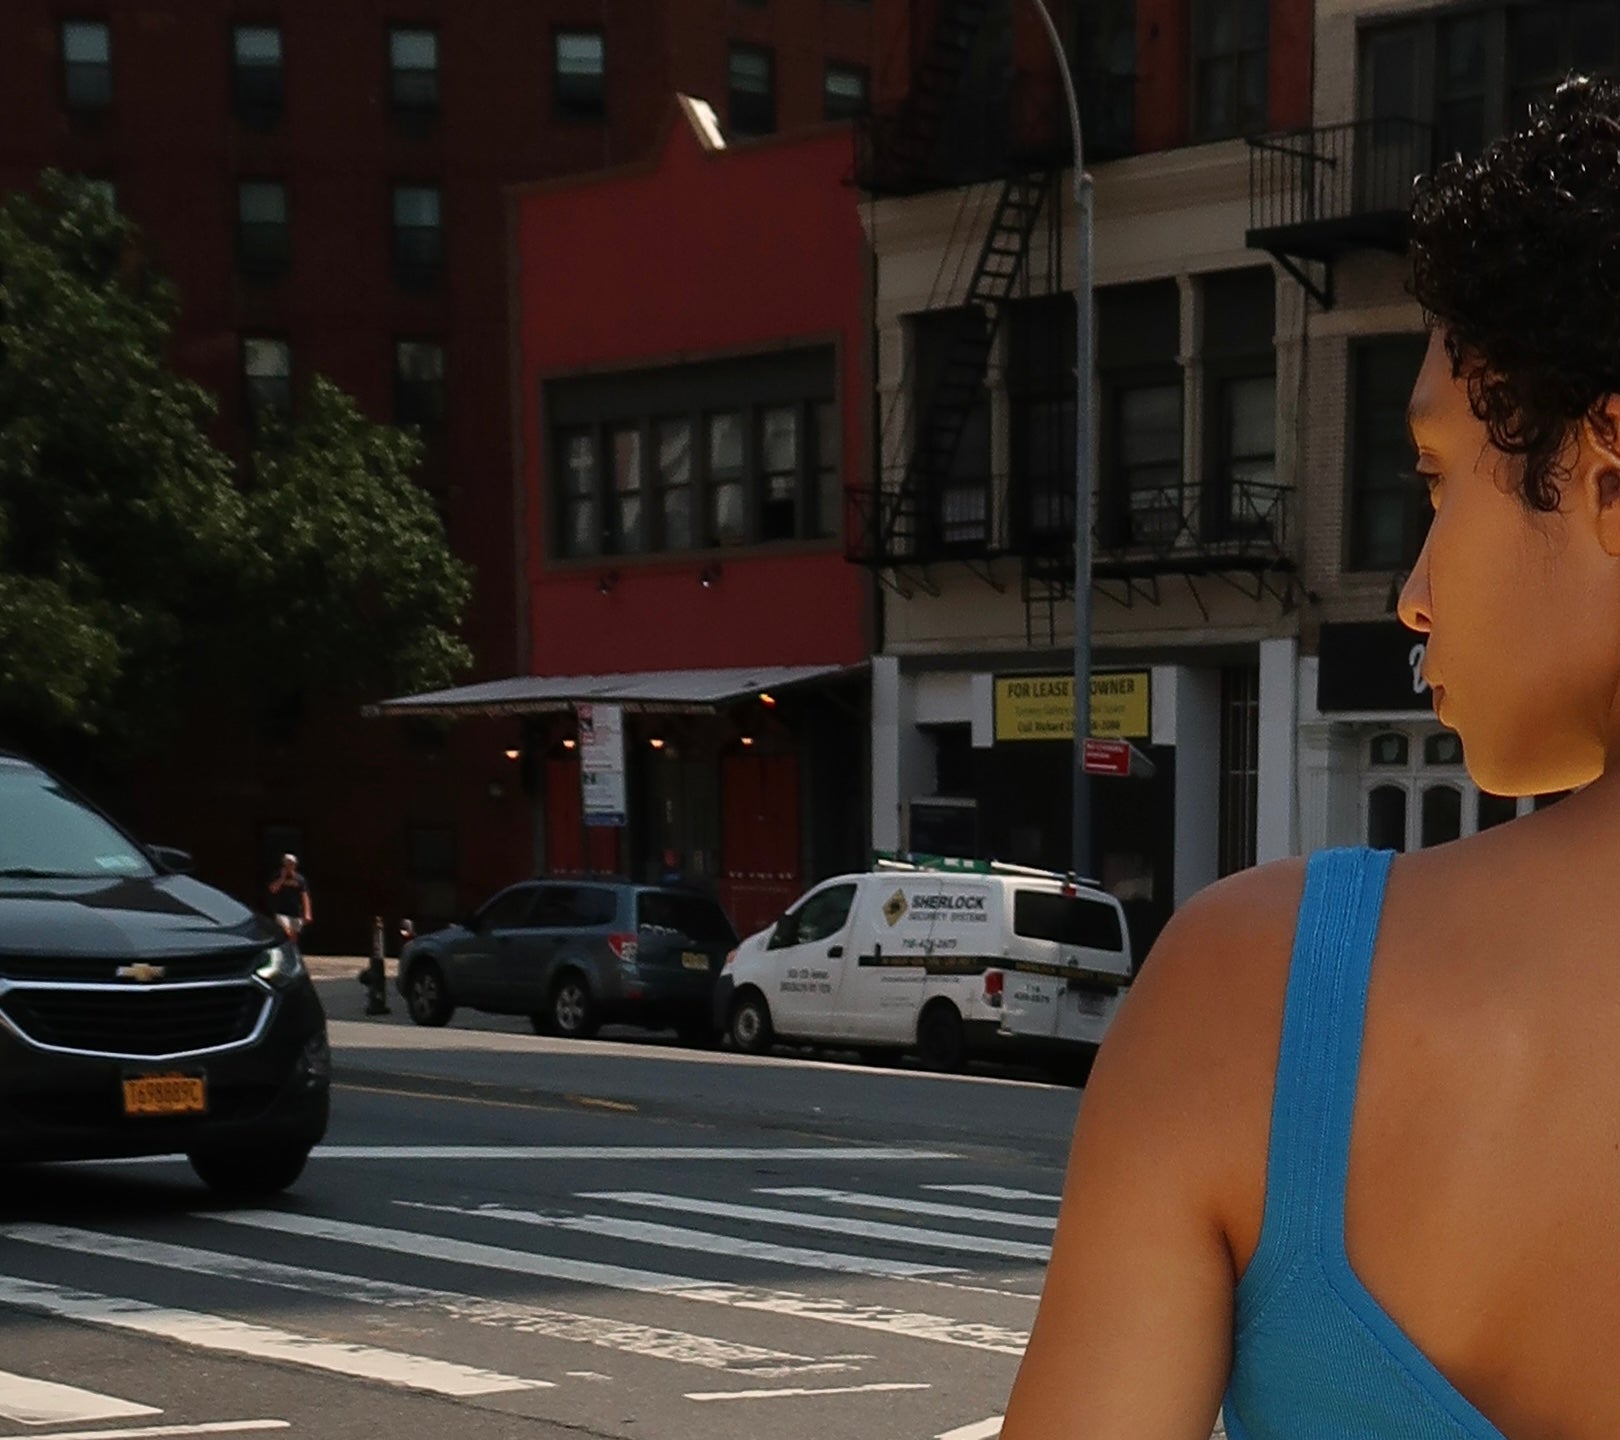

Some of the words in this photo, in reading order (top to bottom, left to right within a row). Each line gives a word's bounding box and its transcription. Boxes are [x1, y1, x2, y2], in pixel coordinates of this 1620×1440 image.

[1008, 682, 1030, 698] FOR
[1033, 681, 1069, 697] LEASE
[1090, 679, 1135, 695] OWNER
[911, 894, 986, 909] SHERLOCK
